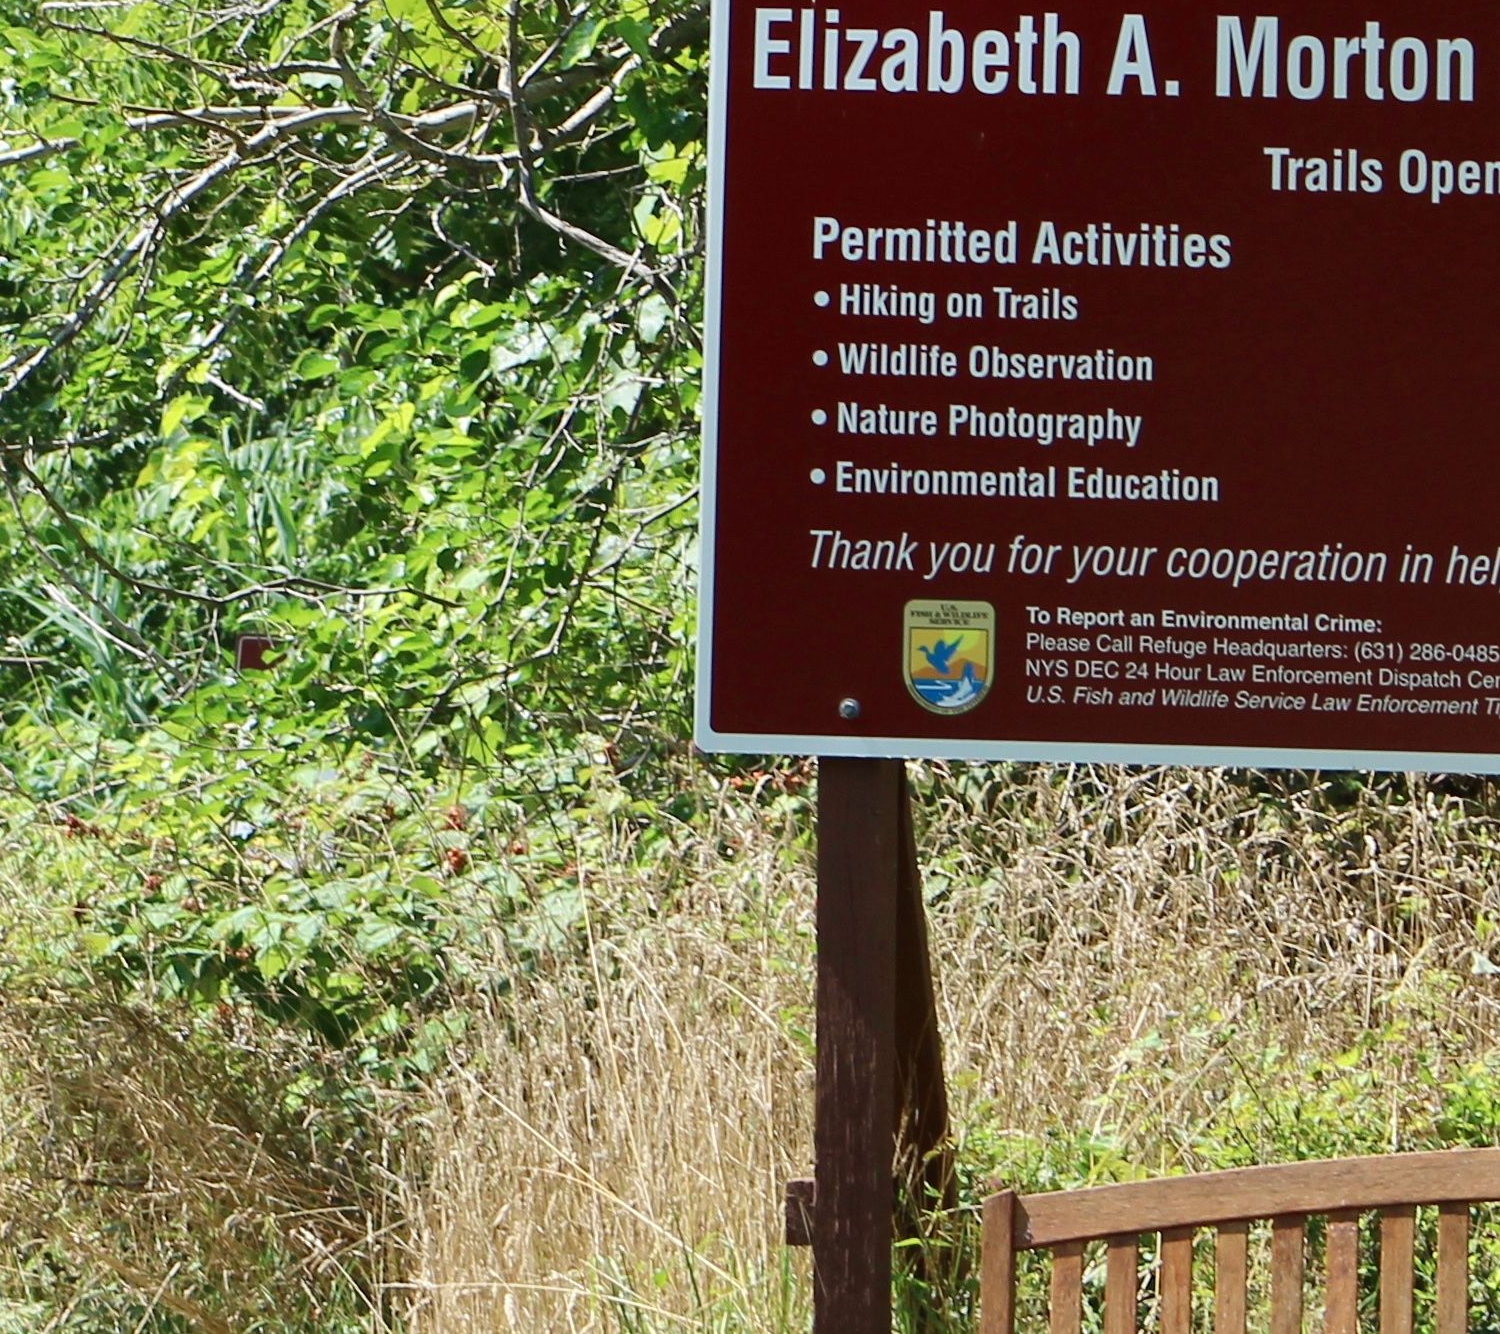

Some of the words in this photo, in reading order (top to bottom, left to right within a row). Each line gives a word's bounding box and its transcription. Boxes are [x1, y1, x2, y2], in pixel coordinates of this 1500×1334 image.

[753, 7, 1080, 95] Elizabeth
[1106, 13, 1180, 97] A.
[1215, 15, 1474, 102] Morton
[1263, 146, 1383, 193] Trails
[813, 216, 1017, 264] Permitted
[1031, 220, 1231, 269] Activities
[840, 283, 935, 324] Hiking
[946, 292, 983, 318] on
[992, 286, 1078, 321] Trails
[837, 342, 958, 377] Wildlife
[968, 345, 1153, 381] Observation
[837, 401, 938, 436] Nature
[948, 404, 1142, 448] Photography
[836, 460, 1056, 498] Environmental
[1067, 466, 1219, 502] Education
[809, 529, 918, 571] Thank
[923, 541, 996, 580] you
[1007, 534, 1063, 574] for
[1066, 545, 1158, 584] your
[1166, 542, 1387, 588] cooperation
[1399, 544, 1434, 584] in
[1025, 606, 1051, 625] To
[1056, 606, 1125, 630] Report
[1129, 612, 1155, 627] an
[1161, 609, 1309, 631] Environmental
[1314, 613, 1382, 633] Crime:
[1026, 632, 1091, 652] Please
[1096, 633, 1133, 653] Call
[1139, 635, 1208, 660] Refuge
[1213, 637, 1348, 661] Headquarters:
[1354, 641, 1404, 664] (631)
[1409, 642, 1500, 663] 286-0485
[1025, 658, 1069, 678] NYS
[1075, 659, 1120, 679] DEC
[1125, 661, 1149, 680] 24
[1155, 662, 1202, 681] Hour
[1207, 663, 1246, 682] Law
[1252, 664, 1373, 686] Enforcement
[1378, 667, 1462, 691] Dispatch
[1026, 685, 1065, 704] U.S.
[1072, 685, 1114, 705] Fish
[1118, 688, 1156, 706] and
[1161, 688, 1230, 708] Wildlife
[1234, 690, 1306, 711] Service
[1311, 692, 1352, 712] Law
[1356, 693, 1479, 716] Enforcement
